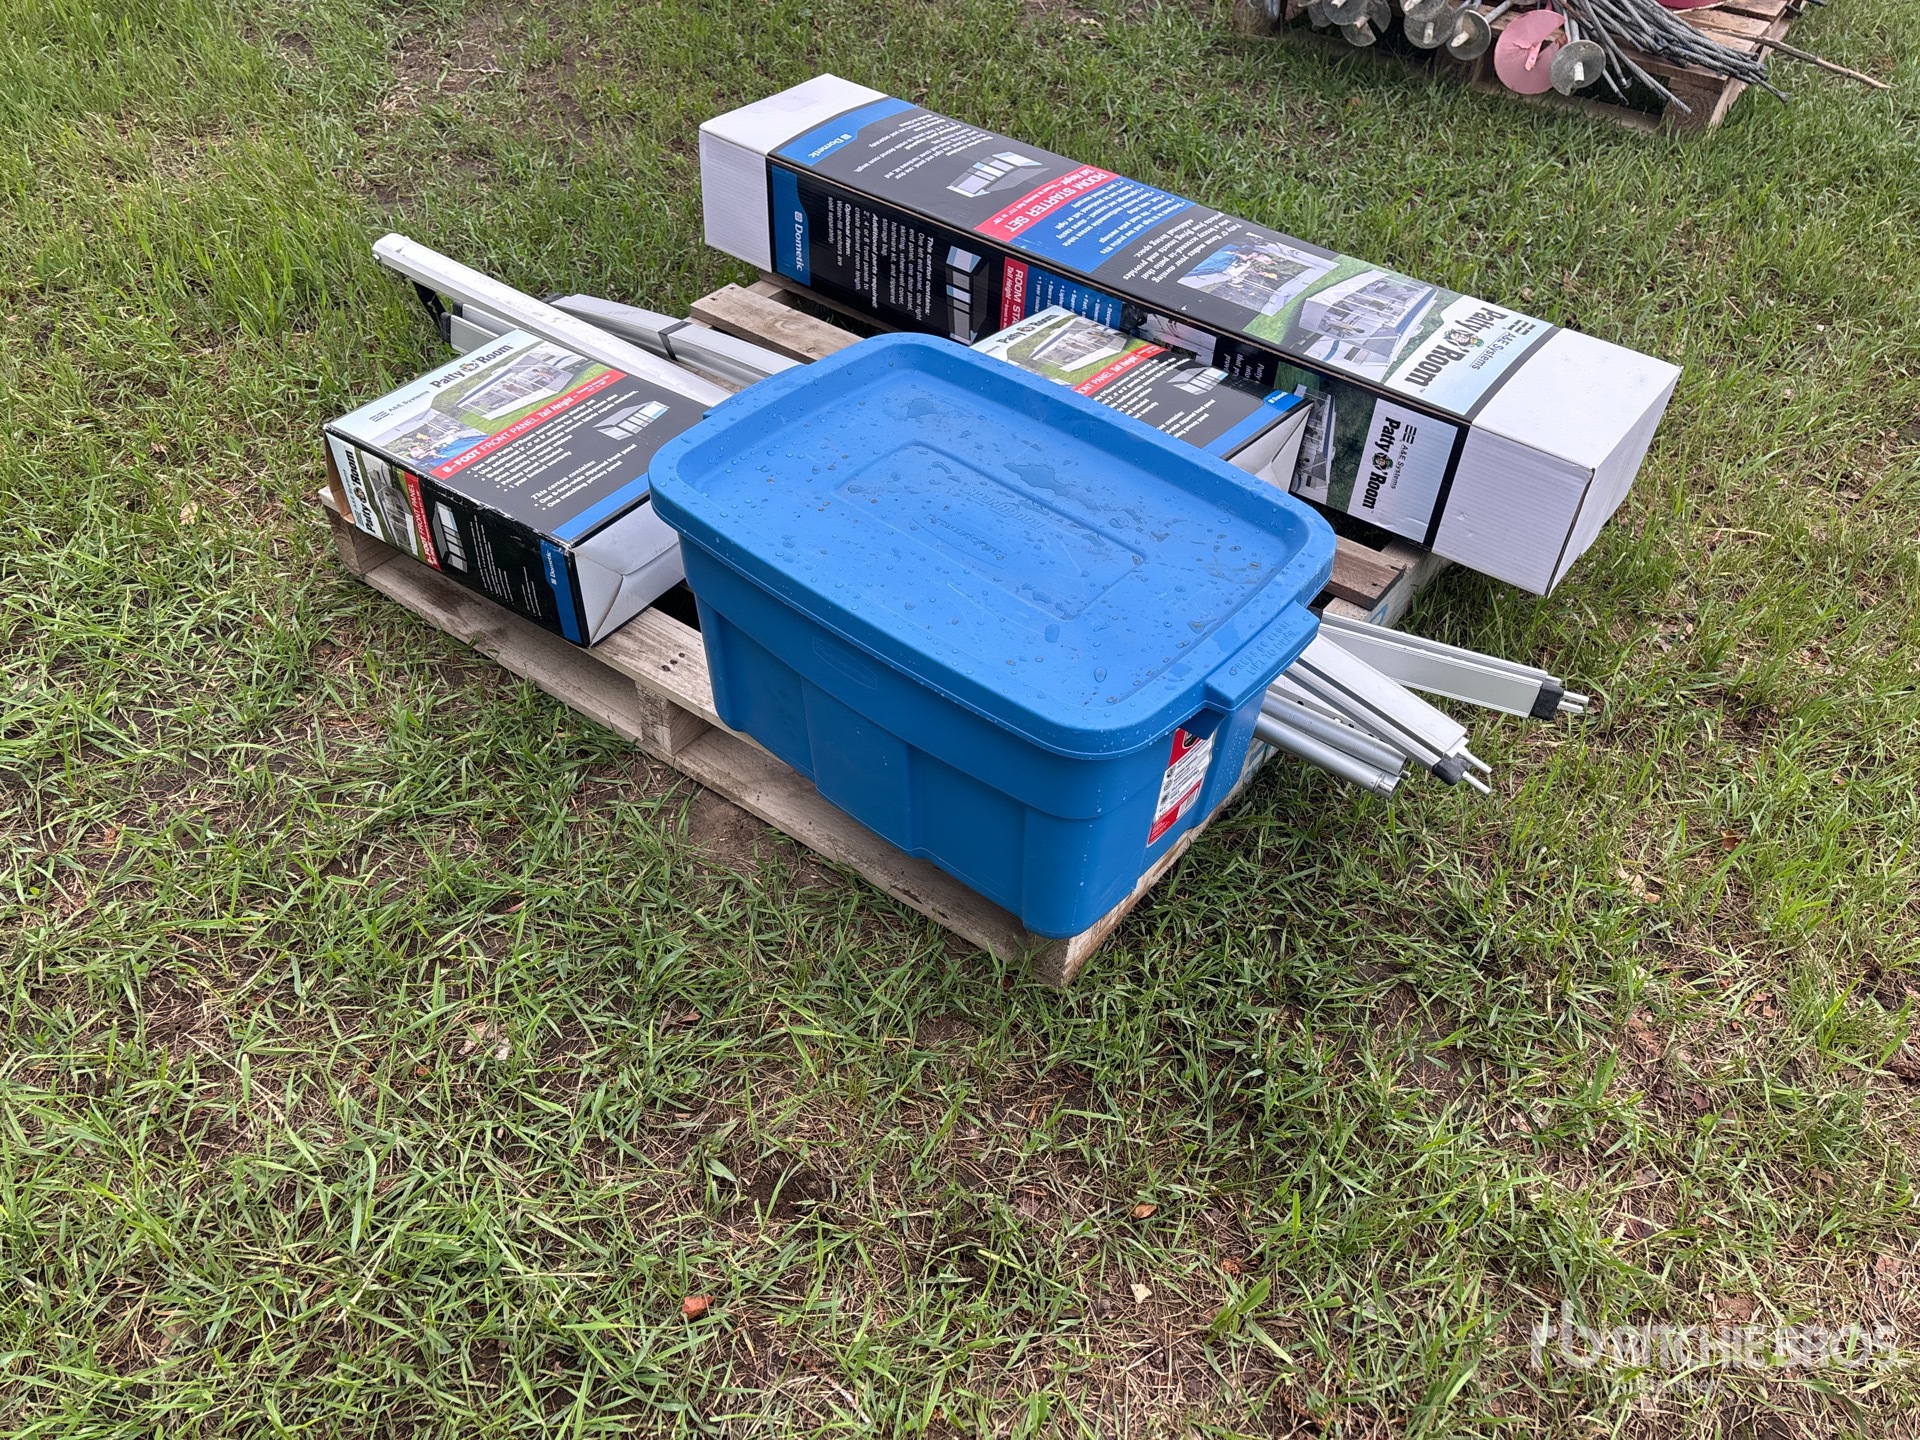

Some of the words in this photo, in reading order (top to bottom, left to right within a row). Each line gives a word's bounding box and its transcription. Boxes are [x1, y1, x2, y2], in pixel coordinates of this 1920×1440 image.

[802, 137, 847, 159] Dometic
[1056, 171, 1085, 186] Height
[1069, 170, 1110, 191] ROOM
[1077, 167, 1096, 177] Tall
[1022, 186, 1078, 217] STARTER
[843, 201, 851, 237] Optional
[853, 205, 861, 228] create
[999, 214, 1032, 232] SET
[1068, 218, 1089, 230] stores
[863, 227, 868, 237] or
[880, 216, 888, 243] storage
[1053, 227, 1075, 239] easily
[1073, 224, 1095, 237] screen
[1095, 228, 1122, 244] awnings
[1171, 227, 1198, 242] flying
[1189, 221, 1209, 232] from
[794, 222, 804, 273] Dometic
[917, 231, 925, 247] One
[926, 235, 934, 254] This
[1059, 235, 1081, 247] fabric
[1147, 232, 1172, 246] living
[1155, 238, 1181, 253] insects
[1165, 235, 1202, 259] screened-in
[1202, 233, 1223, 246] Room
[906, 240, 914, 263] panel,
[916, 245, 924, 259] left
[1129, 243, 1155, 258] space.
[1144, 251, 1163, 262] and
[1185, 242, 1209, 257] makes
[870, 252, 878, 275] parts
[1116, 258, 1153, 281] provides
[1149, 255, 1173, 270] patio
[1170, 253, 1192, 267] your
[915, 270, 923, 292] panel,
[1006, 264, 1014, 279] Tall
[1138, 267, 1158, 280] that
[1148, 264, 1179, 283] awning
[862, 281, 869, 291] to
[888, 275, 896, 304] zippered
[906, 275, 914, 292] door
[1003, 277, 1012, 300] Height
[1012, 268, 1023, 303] ROOM
[923, 279, 931, 316] contains:
[913, 303, 922, 321] right
[1455, 307, 1509, 334] Patty
[1496, 331, 1517, 346] A&E
[1234, 352, 1244, 368] that
[1471, 343, 1505, 371] Systems
[427, 369, 468, 389] Patty
[1088, 370, 1116, 385] PANEL
[1108, 364, 1125, 372] Tall
[1117, 355, 1141, 367] Height
[1243, 364, 1253, 379] into
[1252, 361, 1265, 381] Patty
[400, 388, 432, 405] Systems
[477, 431, 513, 451] FRONT
[507, 415, 540, 434] PANEL
[535, 407, 555, 418] Tall
[548, 395, 577, 411] Height
[469, 461, 486, 471] Use
[481, 454, 499, 464] with
[495, 445, 516, 457] Patty
[533, 421, 556, 435] screen
[552, 413, 570, 424] room
[566, 403, 587, 415] starter
[583, 398, 597, 406] set
[1373, 414, 1401, 455] Patty
[1397, 443, 1409, 461] A&E
[500, 470, 526, 486] Privacy
[521, 461, 543, 474] panel
[537, 446, 565, 463] included
[537, 493, 554, 504] One
[605, 451, 623, 462] front
[618, 442, 638, 455] panel
[1388, 459, 1404, 491] Systems
[528, 488, 549, 500] This
[545, 475, 570, 491] carton
[545, 497, 562, 507] One
[558, 481, 589, 500] matching
[584, 468, 610, 484] privacy
[604, 459, 624, 471] panel
[407, 483, 419, 510] PANEL
[361, 501, 376, 534] Patty
[412, 506, 426, 536] FRONT
[546, 549, 557, 578] Dometic
